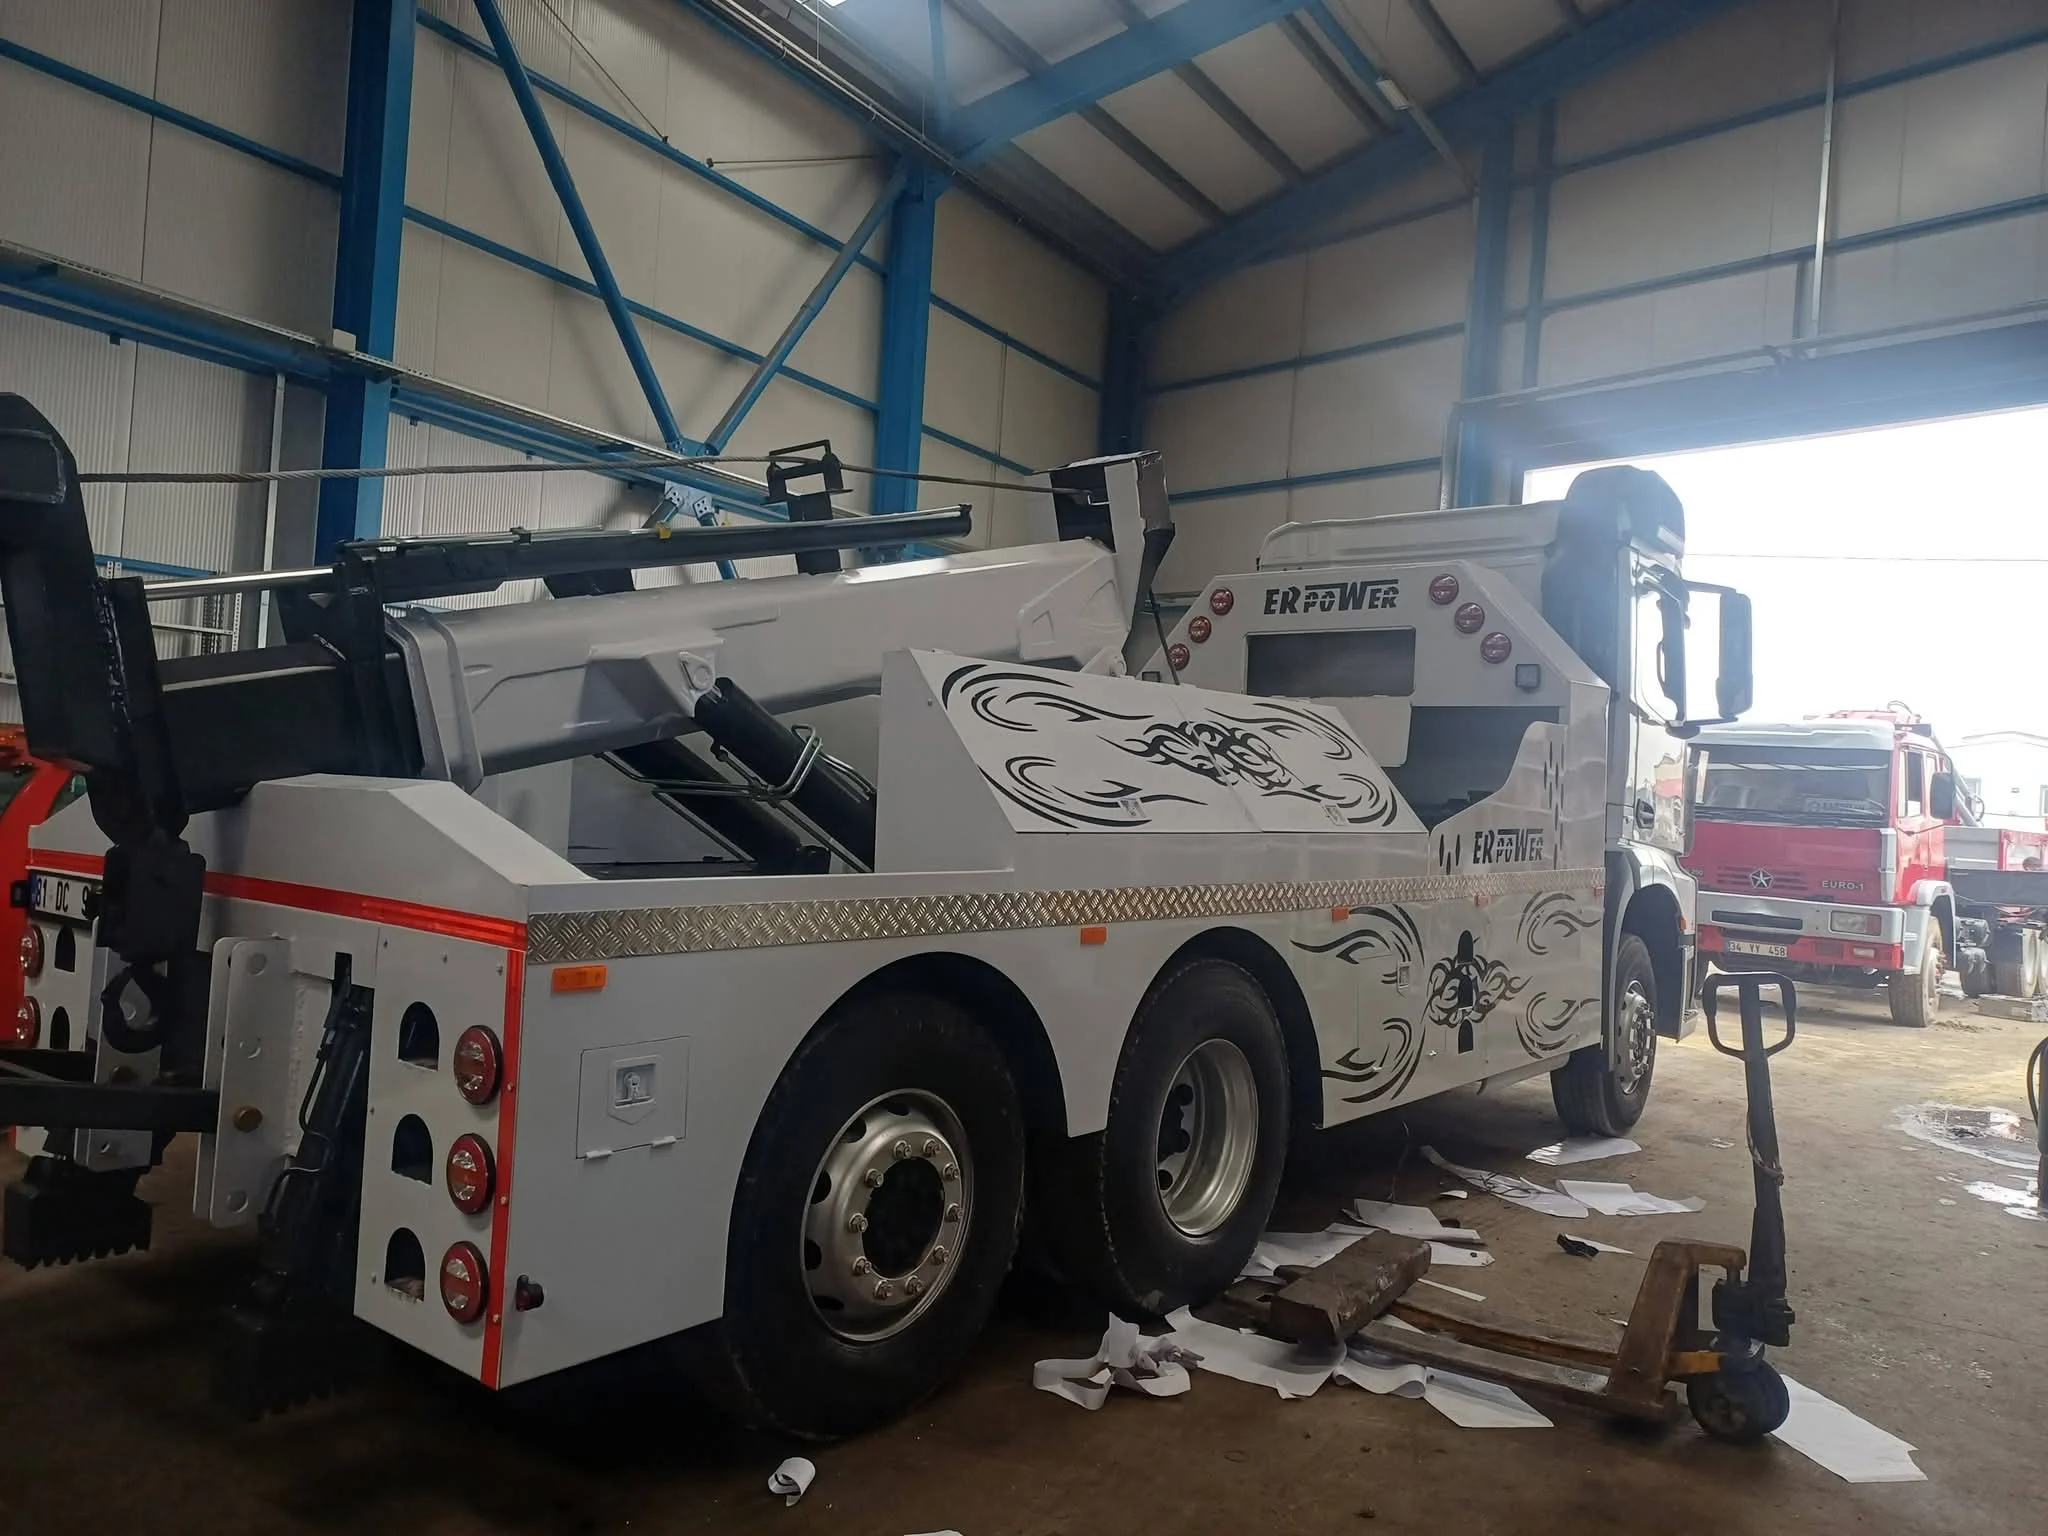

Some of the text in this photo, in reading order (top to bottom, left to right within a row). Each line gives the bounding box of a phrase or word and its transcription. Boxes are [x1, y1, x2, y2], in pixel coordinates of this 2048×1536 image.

[1822, 880, 1864, 892] EURO-1
[55, 880, 70, 913] DC
[1729, 941, 1785, 957] 34 YY 458
